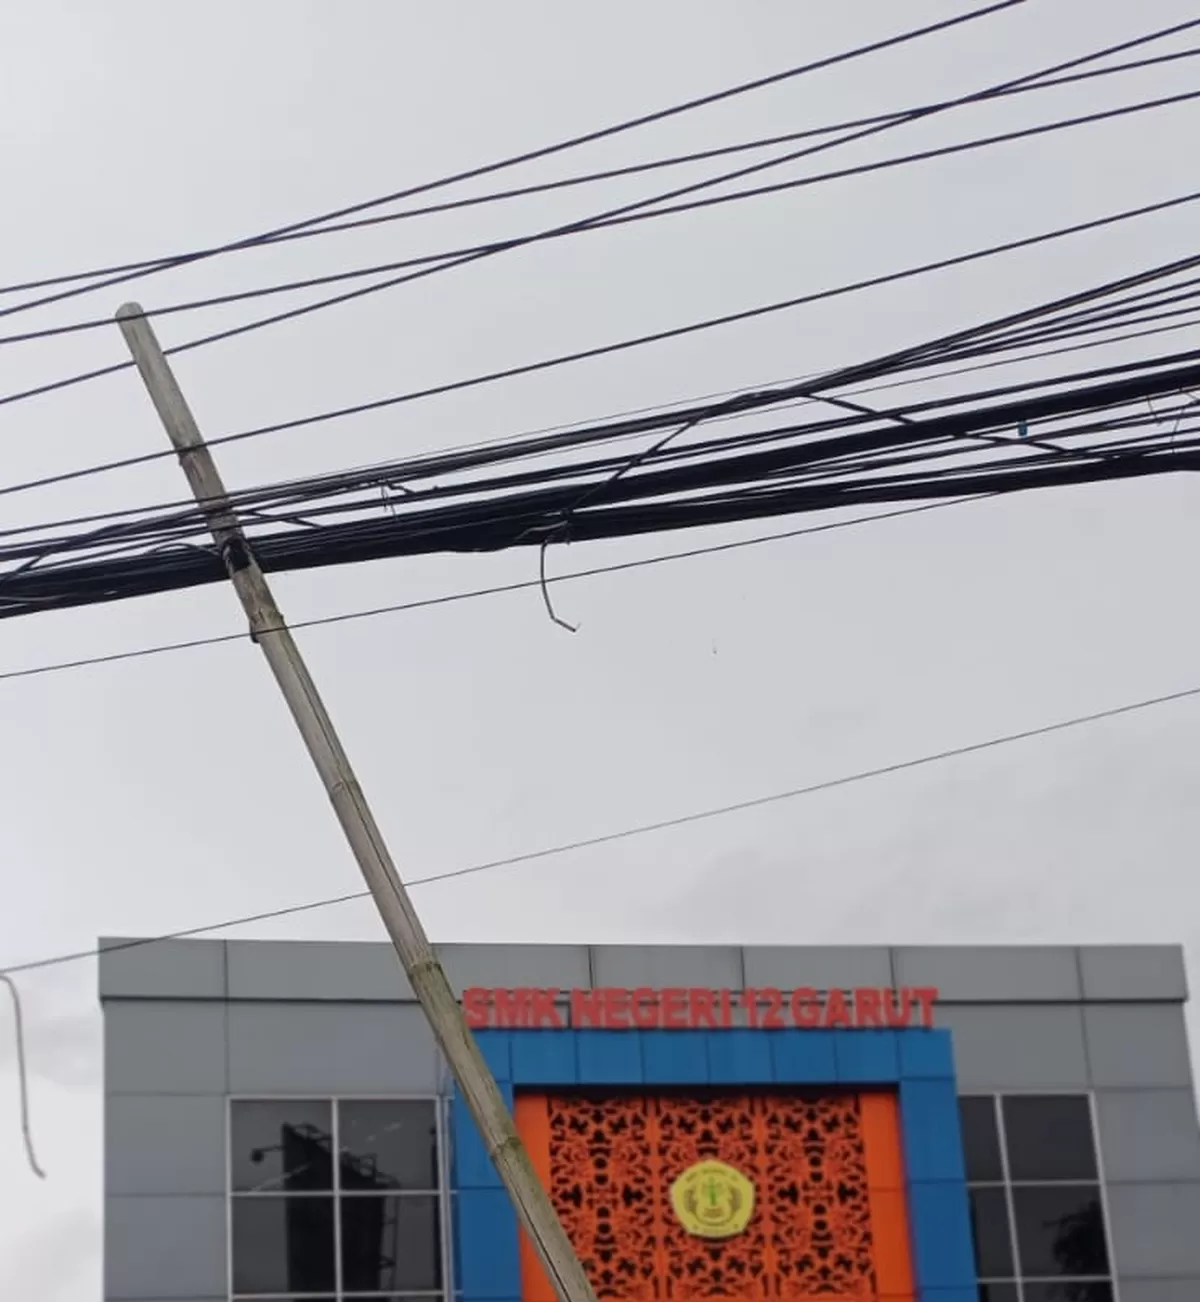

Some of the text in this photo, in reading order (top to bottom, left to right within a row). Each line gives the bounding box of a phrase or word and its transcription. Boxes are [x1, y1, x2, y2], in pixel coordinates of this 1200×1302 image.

[464, 987, 938, 1029] SMK NEGERI 12 GARUT
